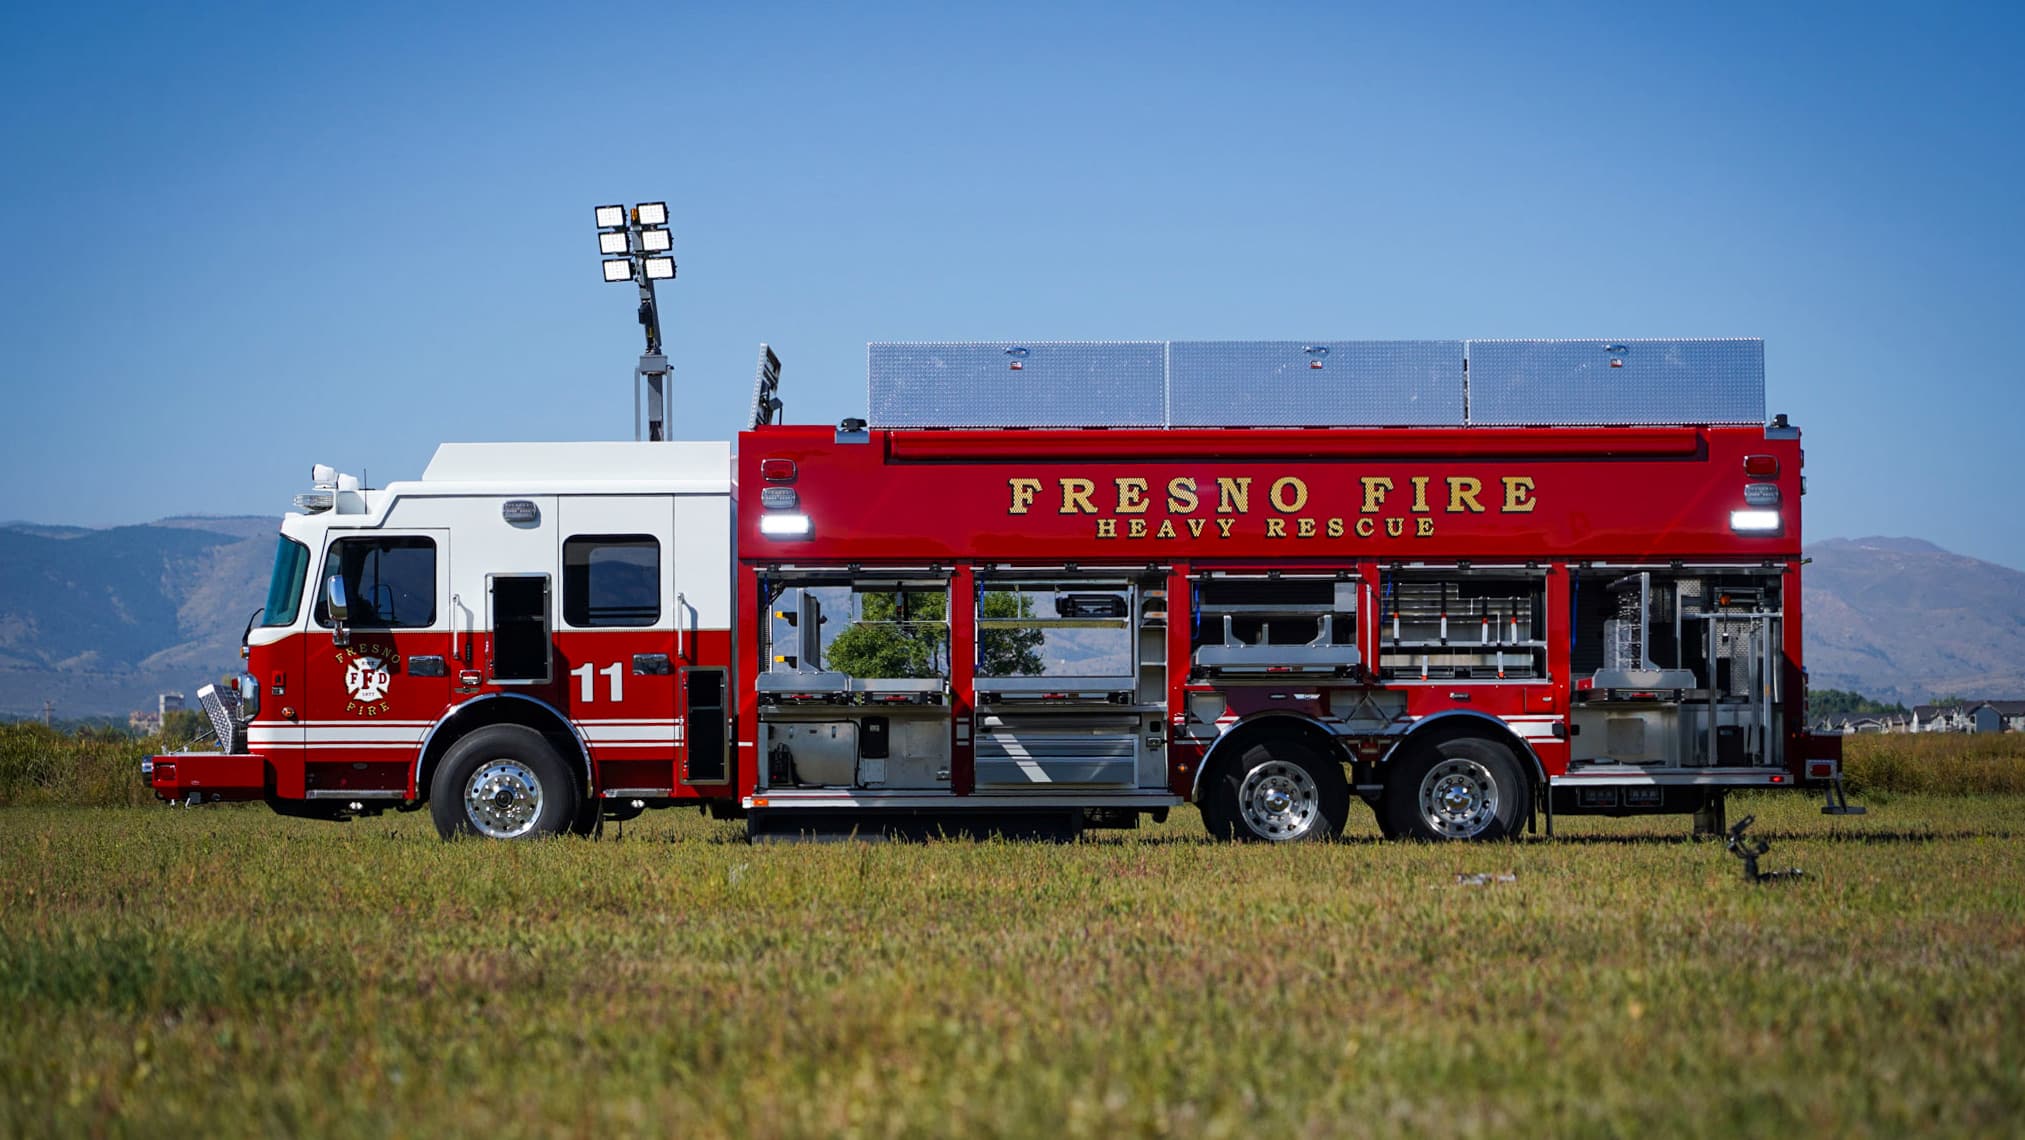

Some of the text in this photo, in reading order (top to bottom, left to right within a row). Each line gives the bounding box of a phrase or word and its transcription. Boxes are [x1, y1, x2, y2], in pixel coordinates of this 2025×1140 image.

[1008, 476, 1537, 514] FRESNO FIRE
[1096, 517, 1434, 538] HEAVY RESCUE
[335, 643, 400, 664] FRESNO
[570, 662, 623, 702] 11
[346, 702, 390, 716] FIRE
